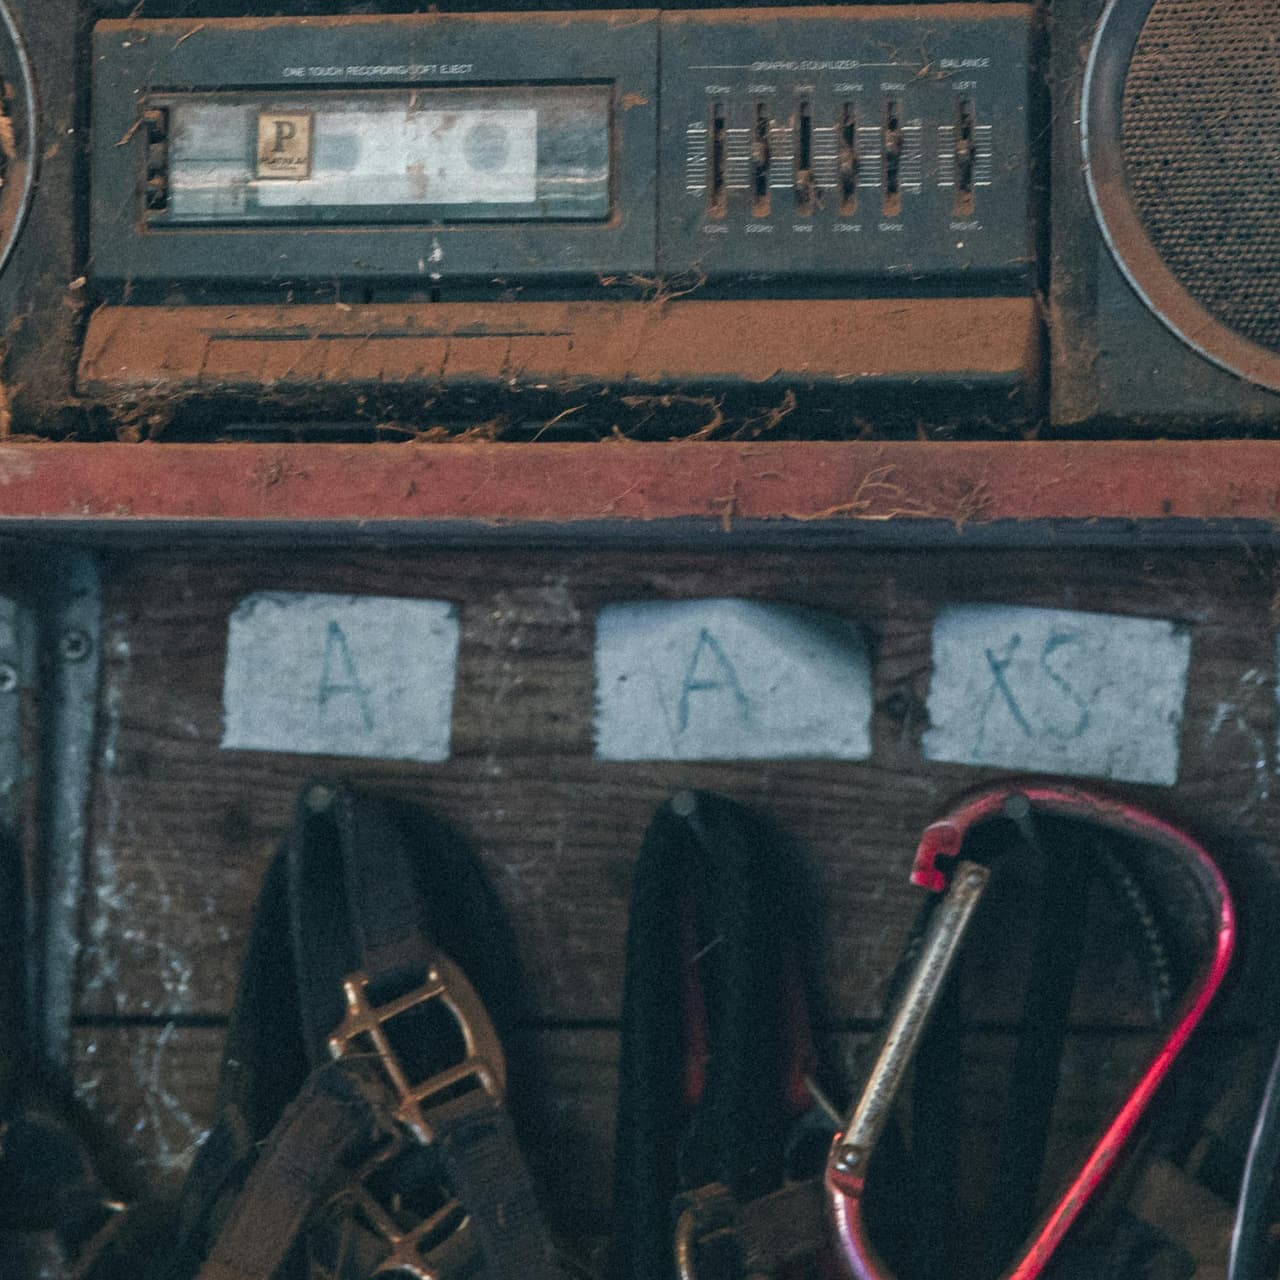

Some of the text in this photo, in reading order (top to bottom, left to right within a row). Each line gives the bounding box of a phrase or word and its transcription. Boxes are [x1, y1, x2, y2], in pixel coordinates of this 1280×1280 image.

[283, 67, 305, 77] ONE
[309, 66, 344, 76] TOUCH
[440, 64, 474, 74] EJECT
[940, 57, 991, 67] BALANCE
[272, 121, 296, 152] P
[319, 619, 374, 734] A
[677, 627, 753, 733] A
